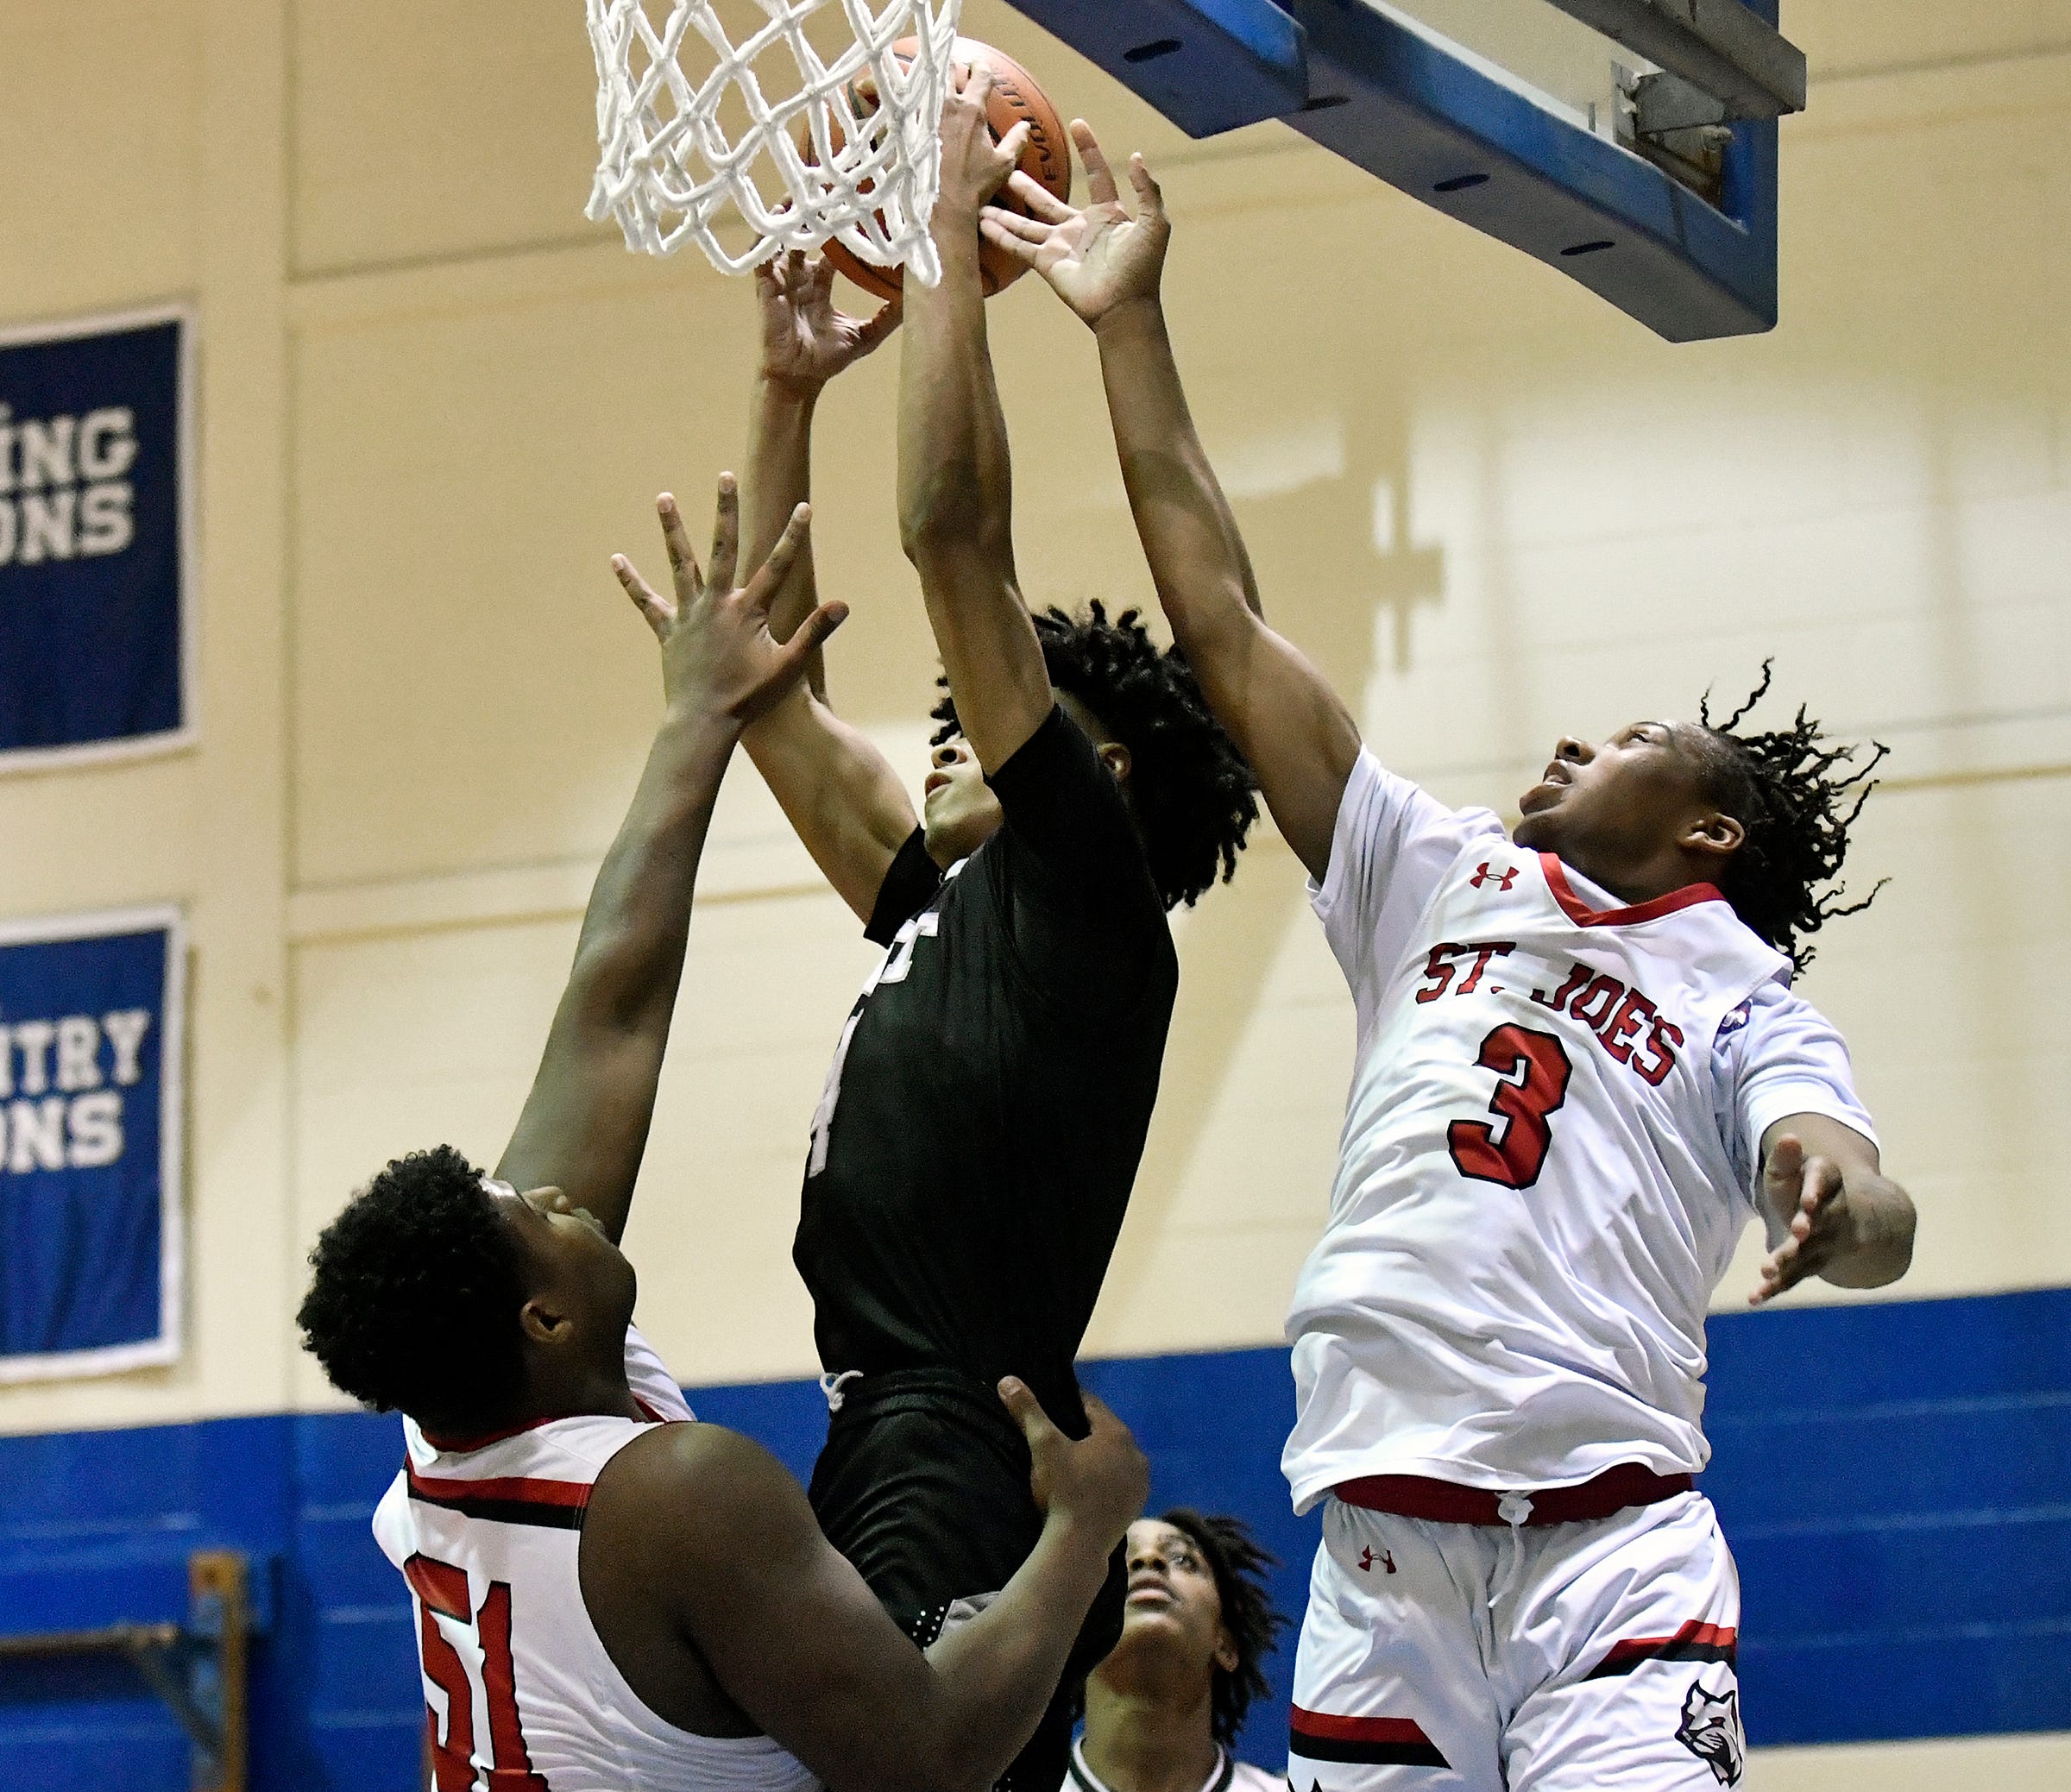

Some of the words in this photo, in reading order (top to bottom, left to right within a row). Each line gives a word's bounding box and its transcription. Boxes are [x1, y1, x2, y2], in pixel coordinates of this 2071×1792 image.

[0, 1008, 150, 1100] TRY
[1415, 941, 1516, 1004] ST.
[1530, 962, 1684, 1086] JOES
[0, 1091, 125, 1175] NS
[1446, 1022, 1573, 1190] 3
[403, 1550, 552, 1792] 51
